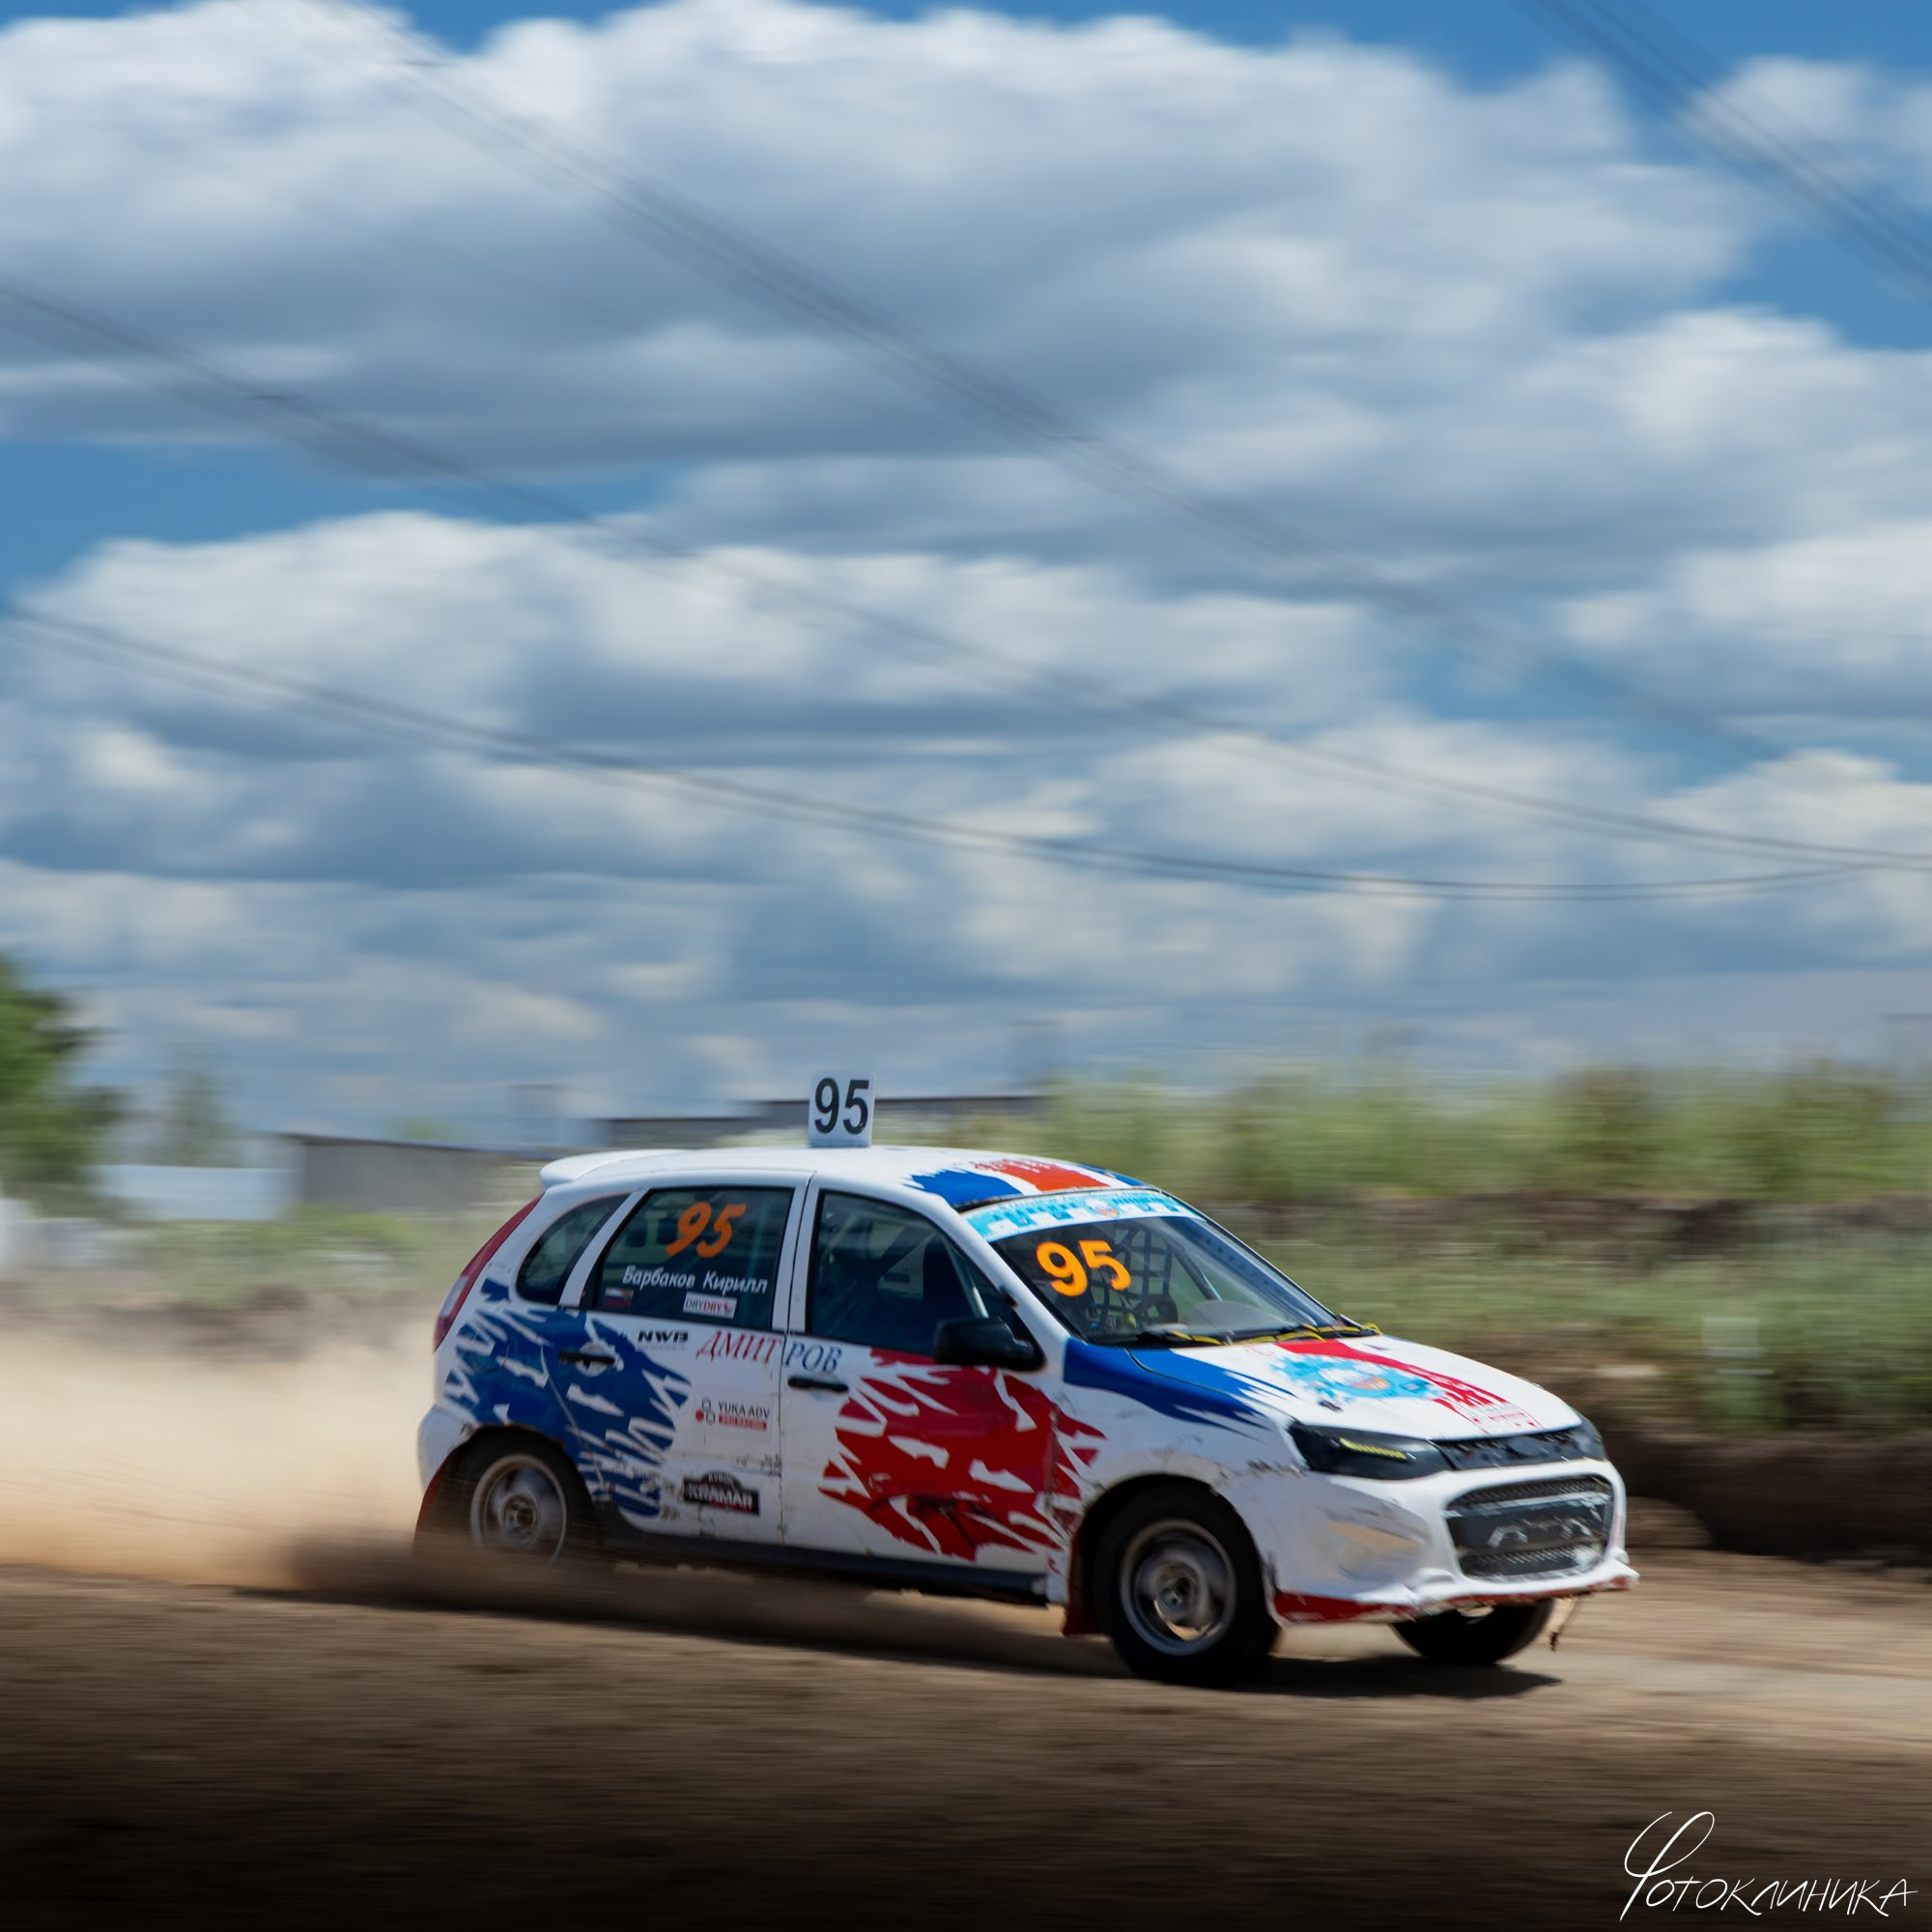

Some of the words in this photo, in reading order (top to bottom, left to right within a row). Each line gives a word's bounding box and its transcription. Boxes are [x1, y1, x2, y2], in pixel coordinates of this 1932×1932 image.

[813, 1077, 869, 1135] 95
[666, 1202, 747, 1258] 95
[622, 1265, 696, 1291] Барбаков
[702, 1270, 768, 1296] Кирилл
[1037, 1240, 1131, 1296] 95
[638, 1329, 689, 1343] NWB
[719, 1401, 746, 1416] YUKA
[748, 1405, 771, 1419] ADV
